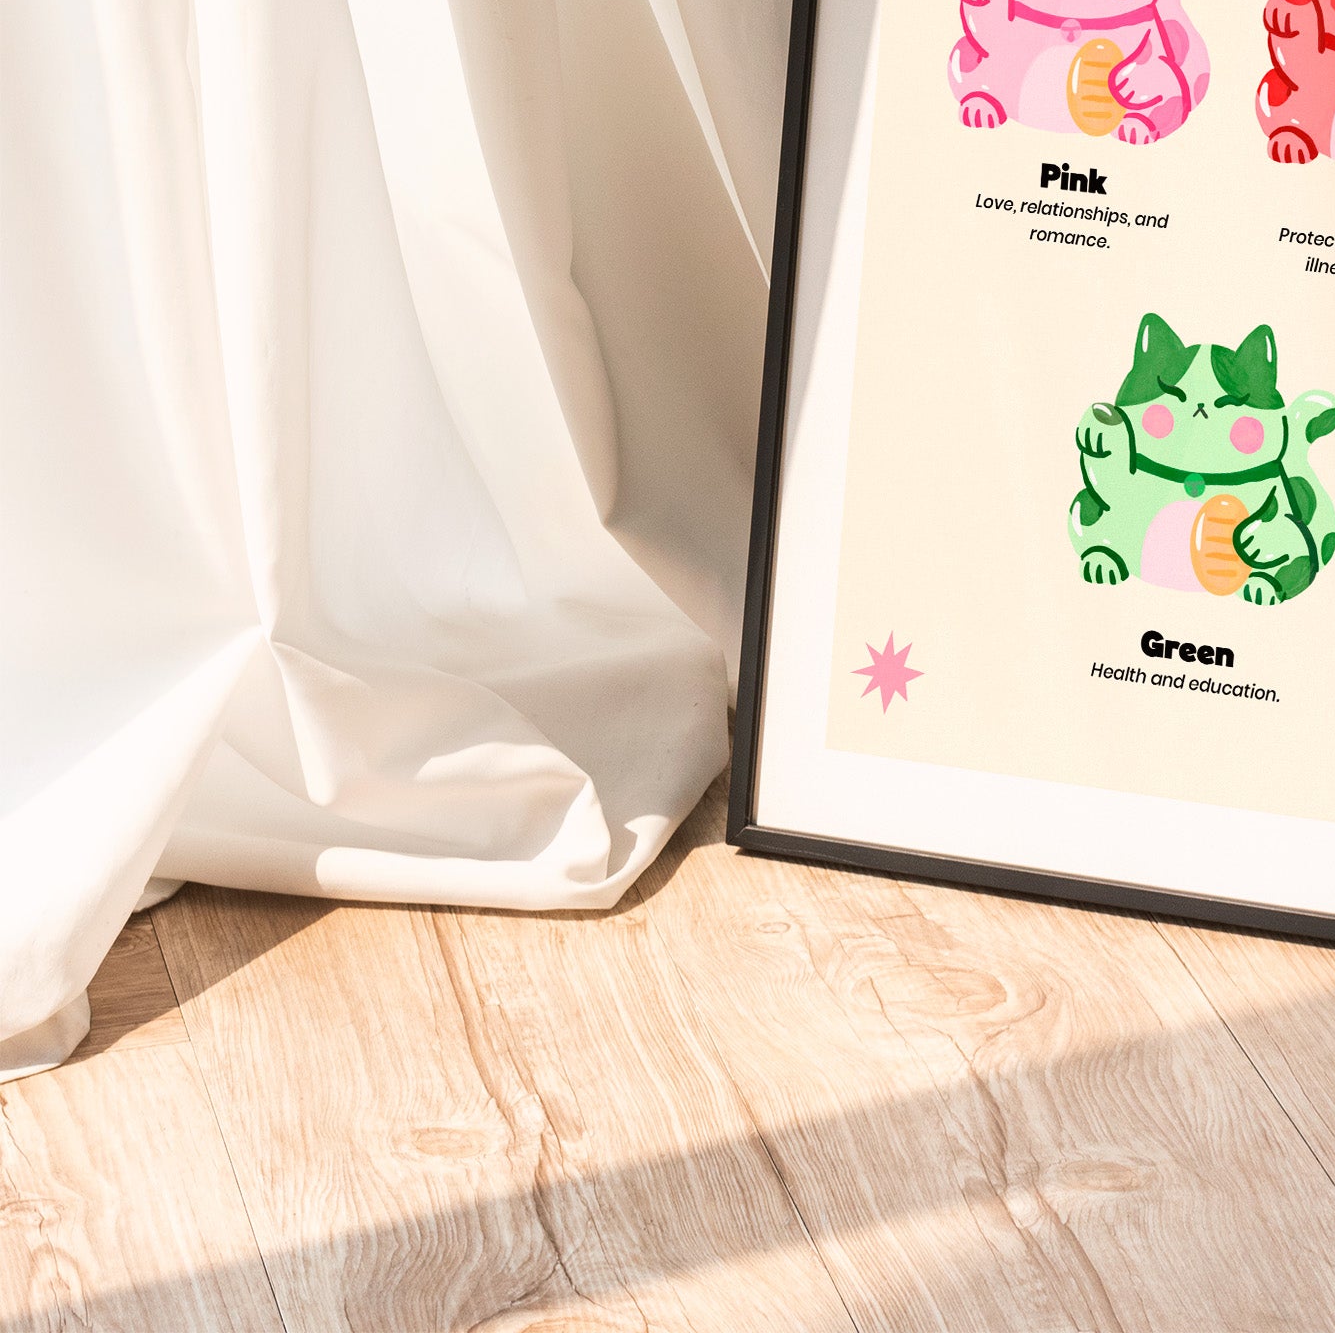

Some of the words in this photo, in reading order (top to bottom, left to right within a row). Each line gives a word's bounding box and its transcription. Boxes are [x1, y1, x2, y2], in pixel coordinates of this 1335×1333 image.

[1040, 162, 1108, 195] Pink
[975, 193, 1017, 214] Love,
[1020, 200, 1131, 228] relationships,
[1134, 214, 1170, 229] and
[1029, 228, 1110, 249] romance.
[1140, 630, 1235, 668] Green
[1090, 662, 1147, 684] Health
[1150, 673, 1186, 690] and
[1188, 677, 1280, 703] education.
